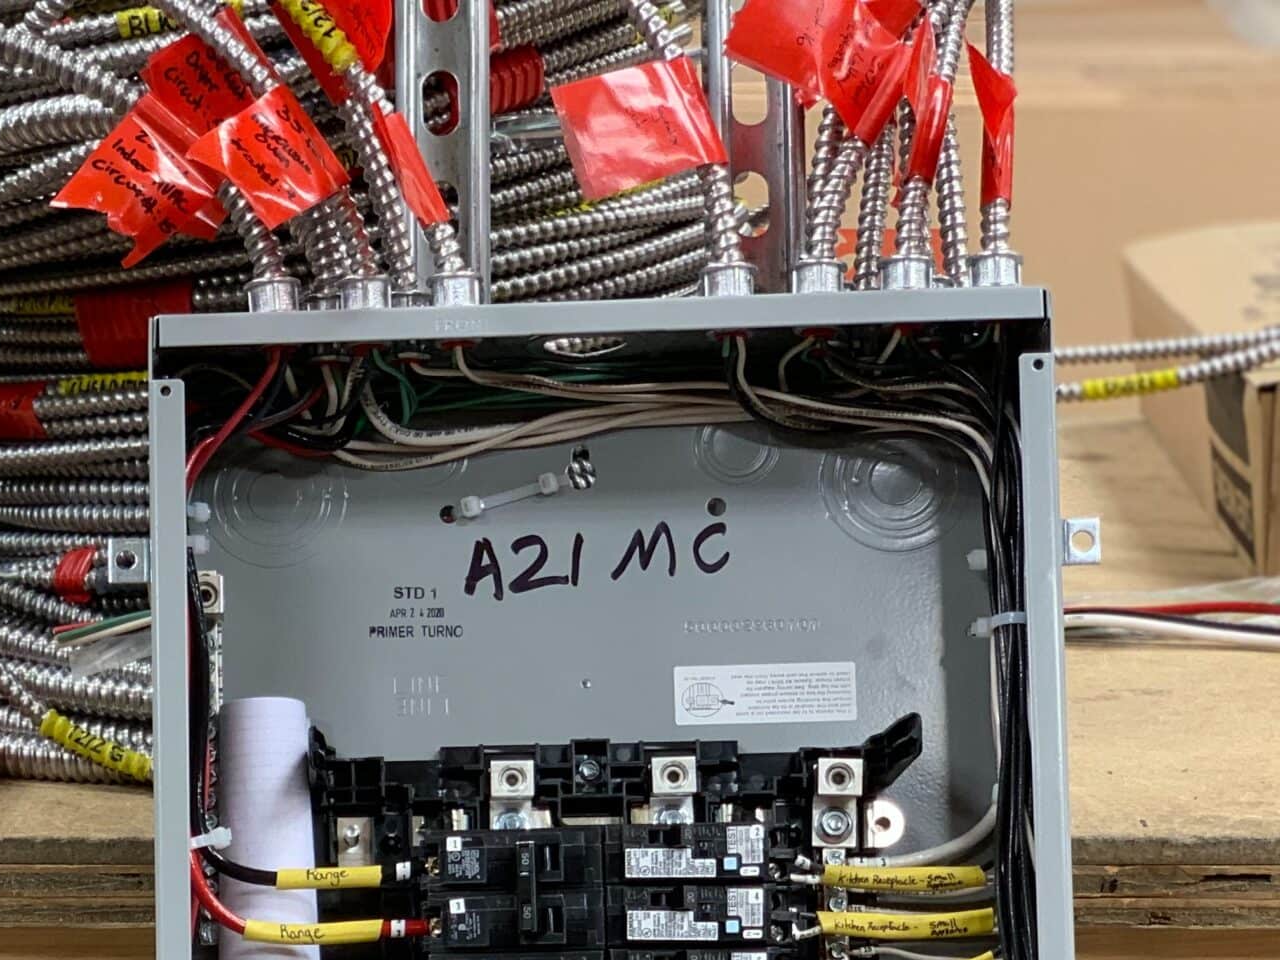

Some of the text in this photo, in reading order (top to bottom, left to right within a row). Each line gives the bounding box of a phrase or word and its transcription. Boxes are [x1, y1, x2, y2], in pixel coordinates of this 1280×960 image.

[464, 532, 584, 601] A21
[393, 587, 437, 600] STD 1
[390, 608, 407, 619] APR
[369, 625, 463, 639] PRIMER TURNO
[728, 827, 737, 853] TEST
[521, 852, 530, 866] 50
[306, 869, 349, 887] Range
[838, 871, 869, 883] Kitchen
[927, 872, 955, 882] Small
[728, 889, 737, 913] TEST
[523, 906, 532, 919] 50
[834, 919, 866, 932] Kitchen
[930, 918, 958, 928] Small
[280, 927, 326, 941] Range
